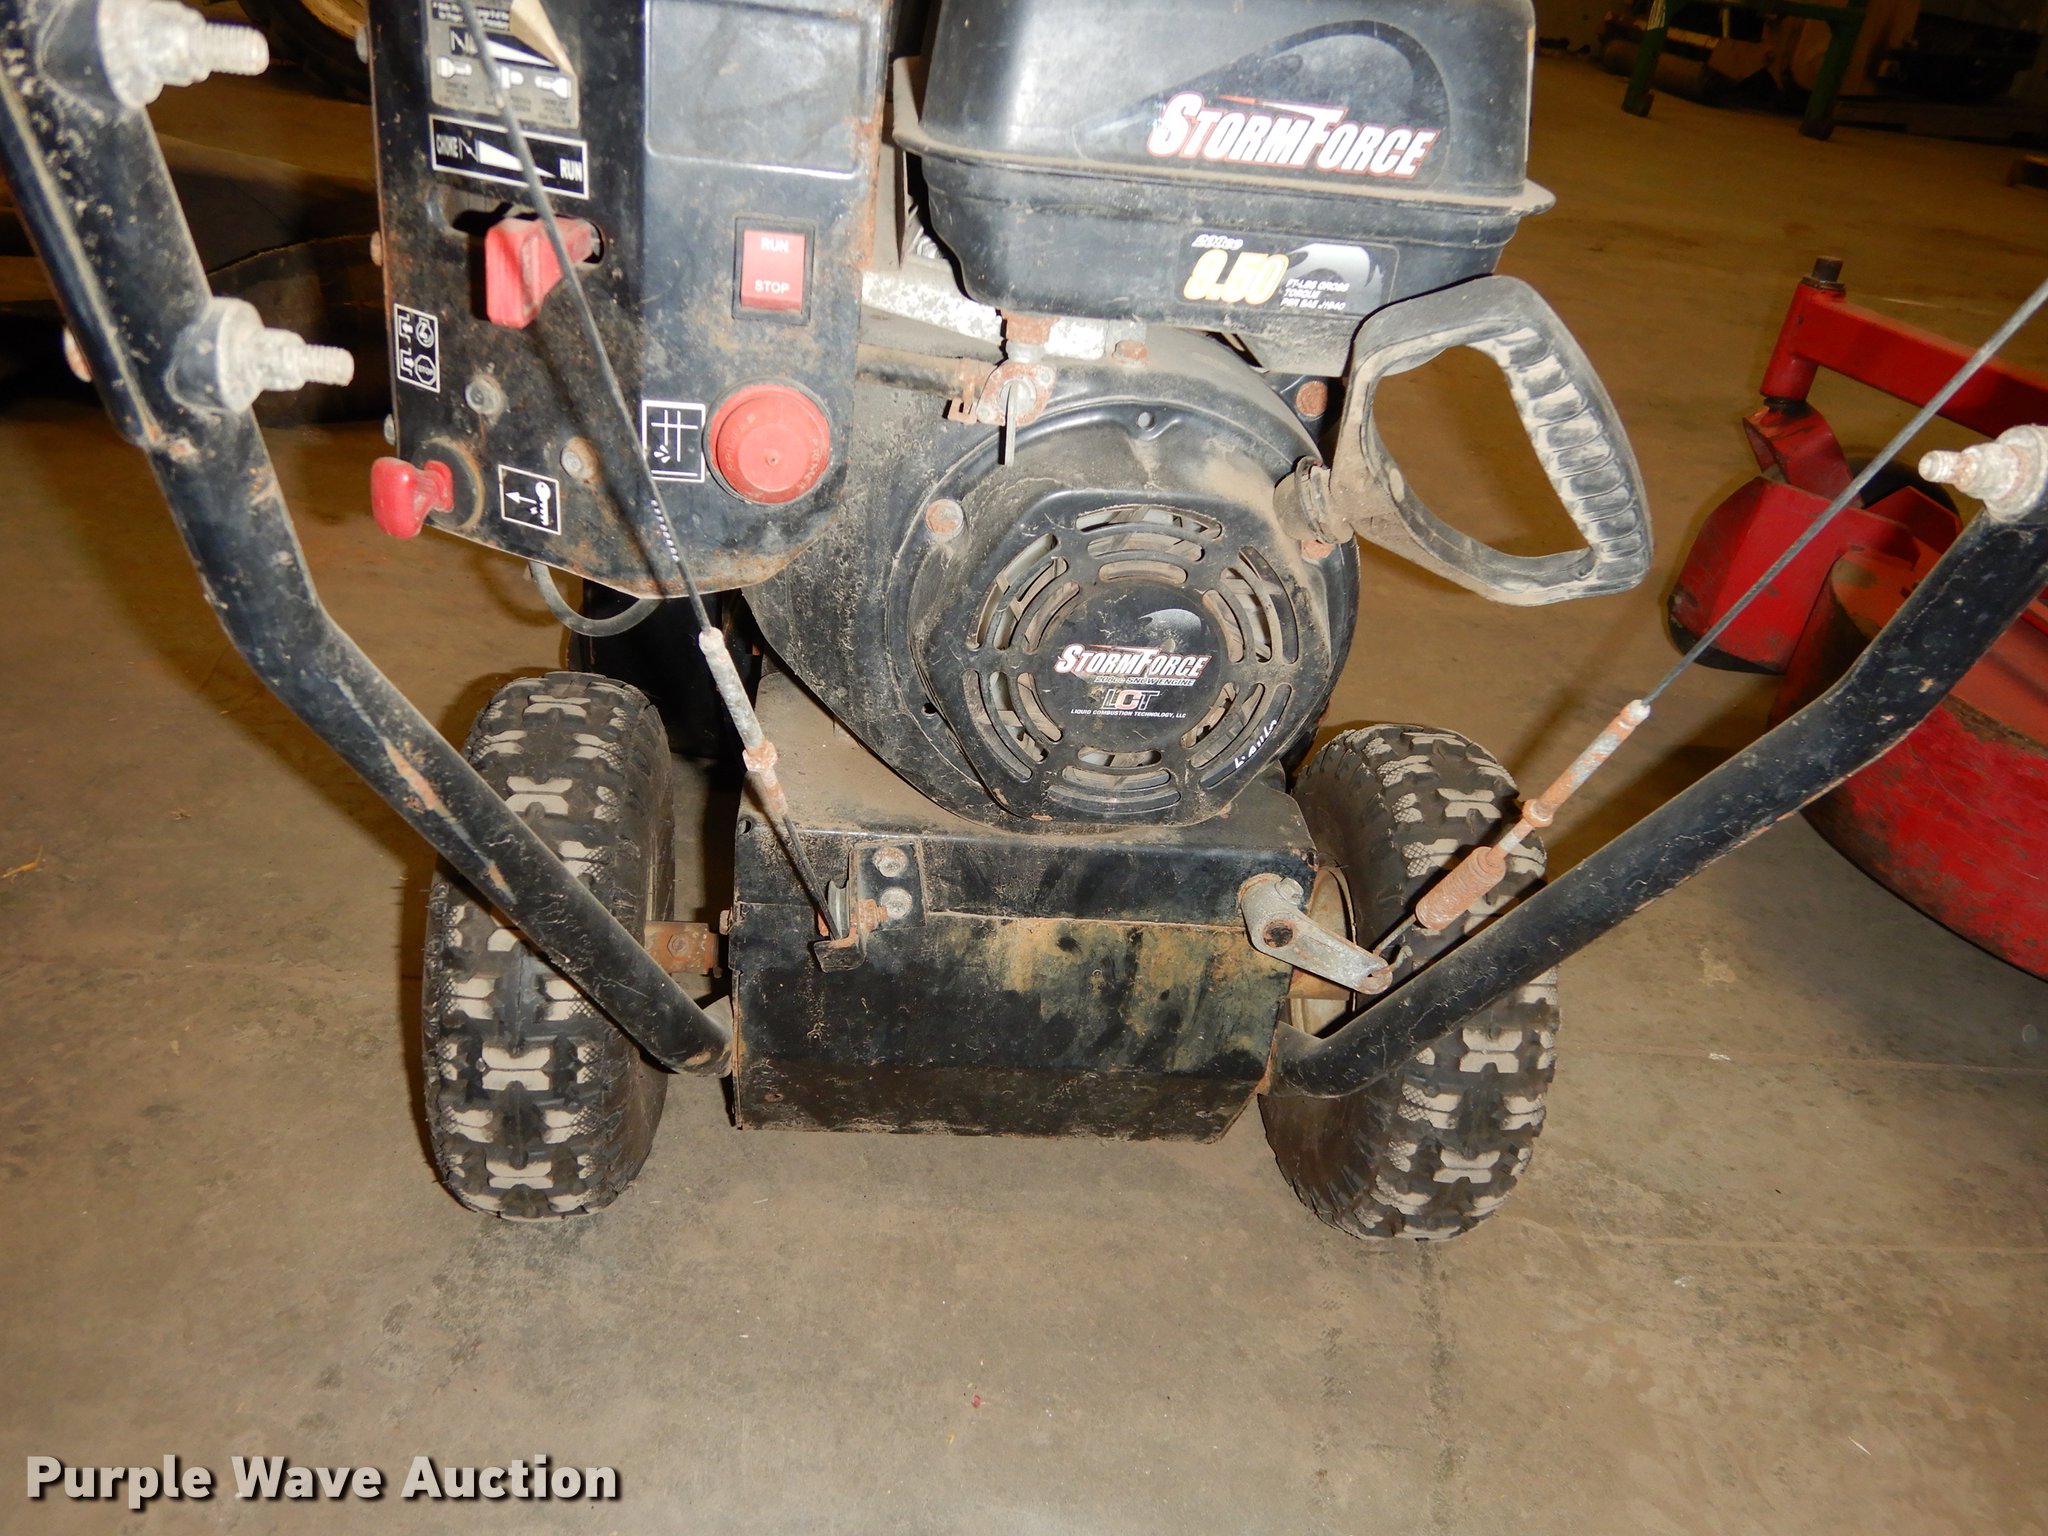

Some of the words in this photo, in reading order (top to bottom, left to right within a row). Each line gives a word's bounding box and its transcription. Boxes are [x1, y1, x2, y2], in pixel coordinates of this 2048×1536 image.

[560, 158, 583, 181] RUN
[760, 236, 789, 253] RUN
[754, 279, 790, 294] STOP
[1126, 677, 1157, 685] SNOW
[1156, 678, 1197, 687] ENGINE
[1101, 689, 1160, 711] LCT
[1092, 709, 1132, 717] COMBUSTION
[1134, 711, 1175, 719] TECHNOLOGY,
